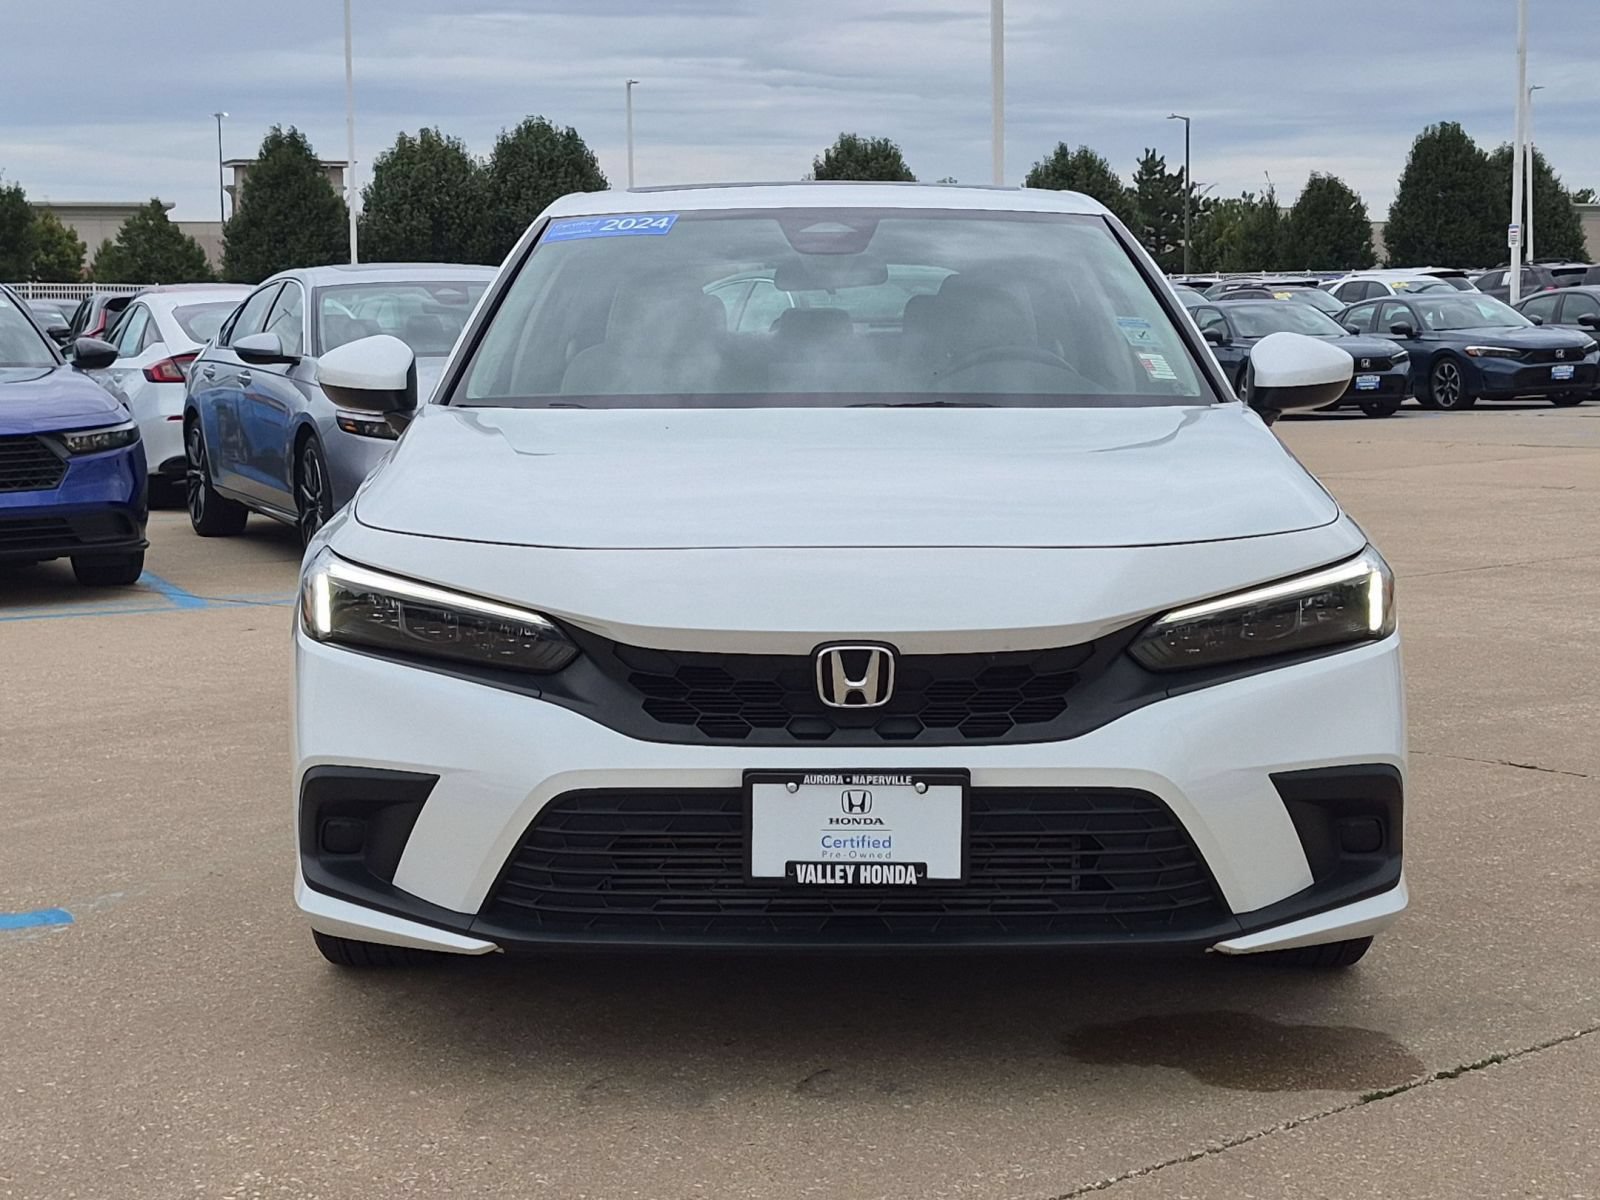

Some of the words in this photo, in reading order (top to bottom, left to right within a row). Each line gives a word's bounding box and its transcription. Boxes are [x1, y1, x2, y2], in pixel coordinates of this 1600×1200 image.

[599, 217, 669, 231] 2024
[803, 774, 844, 785] AURORA
[851, 775, 913, 785] NAPERVILLE
[828, 817, 885, 825] HONDA
[821, 835, 892, 848] Certified
[821, 850, 892, 859] Pre-Owned
[795, 863, 856, 884] VALLEY
[860, 864, 917, 885] HONDA
